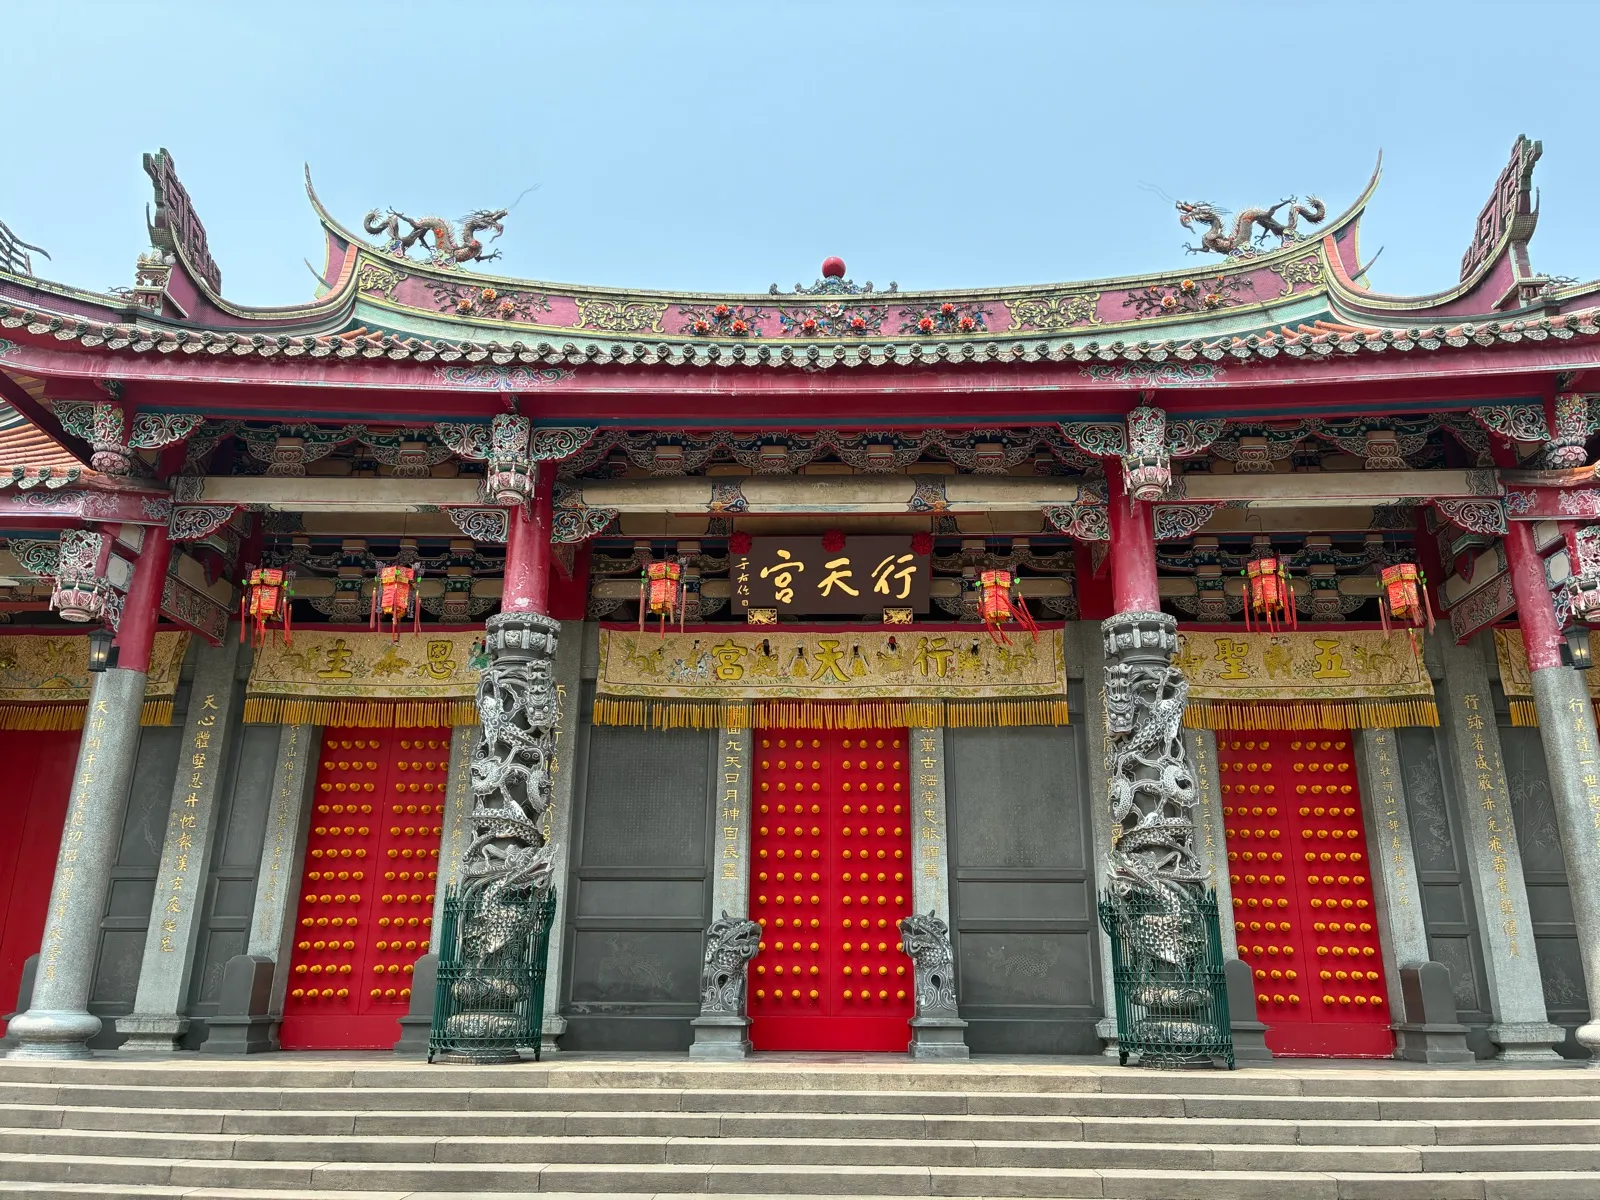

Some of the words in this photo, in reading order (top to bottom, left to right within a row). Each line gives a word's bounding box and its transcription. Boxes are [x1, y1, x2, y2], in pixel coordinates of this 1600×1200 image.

[760, 549, 917, 604] 行天宮
[711, 637, 955, 682] 行天宮
[721, 699, 743, 880] 九天日月神自長靈
